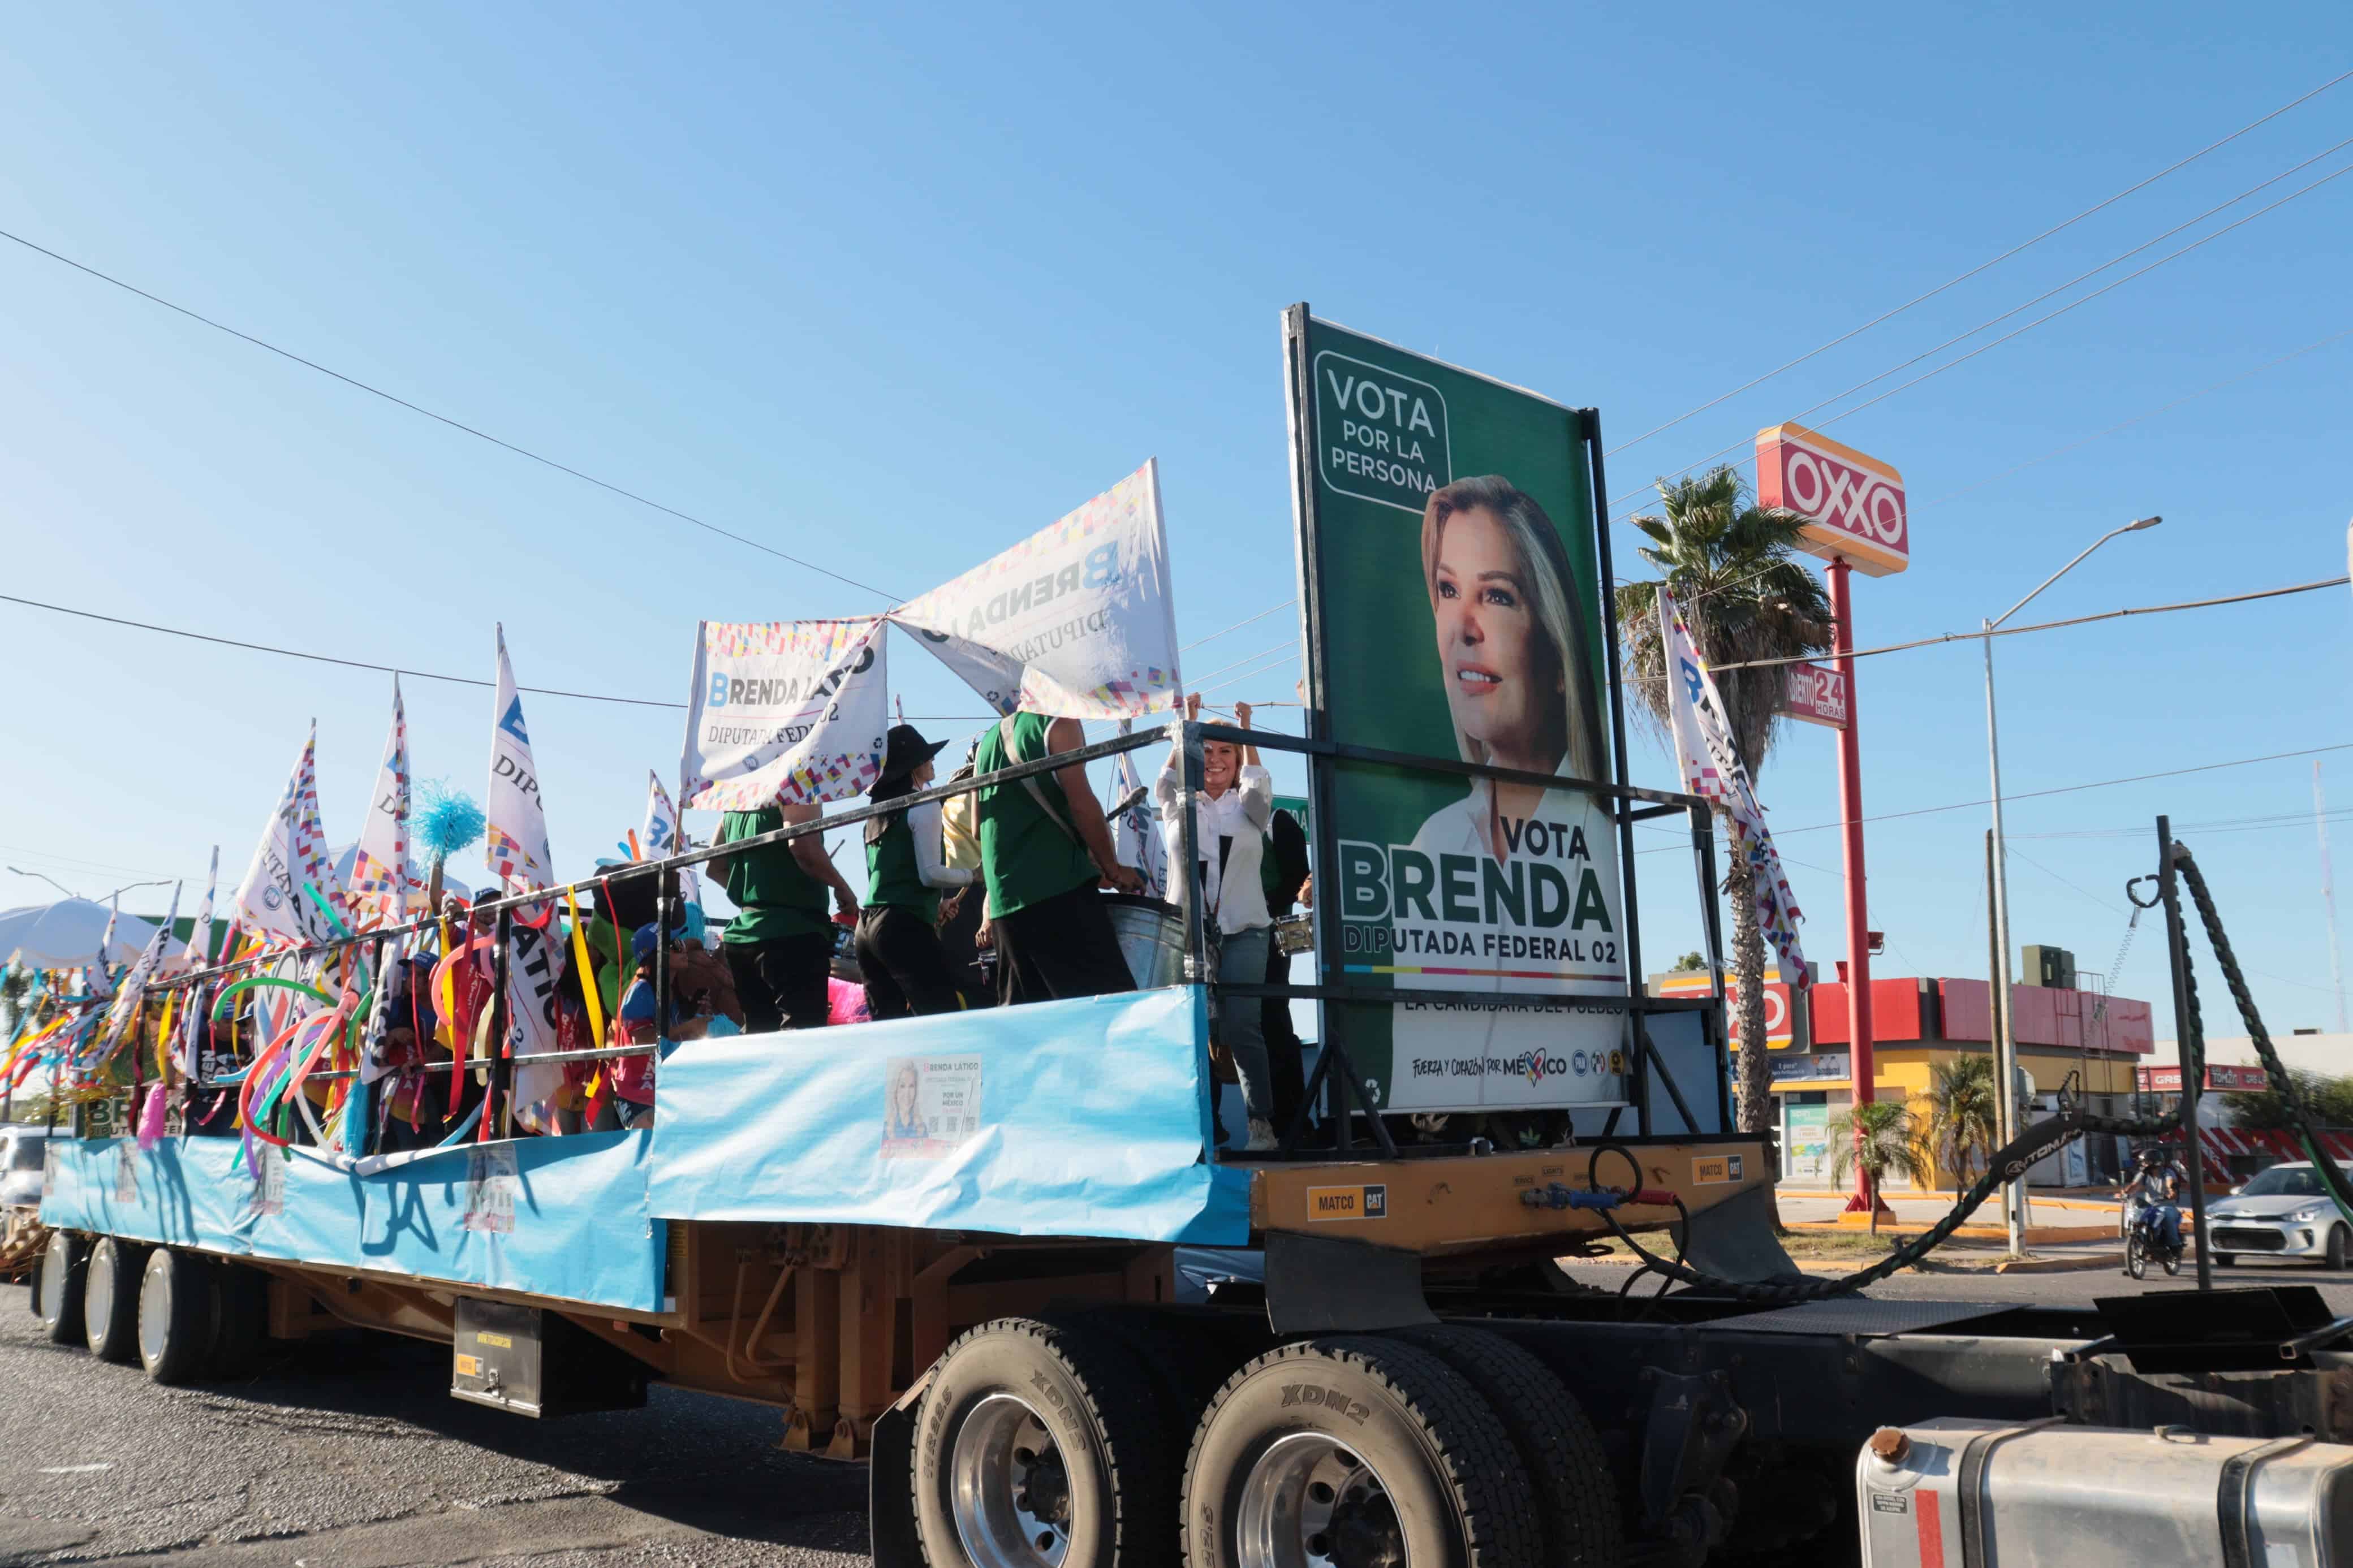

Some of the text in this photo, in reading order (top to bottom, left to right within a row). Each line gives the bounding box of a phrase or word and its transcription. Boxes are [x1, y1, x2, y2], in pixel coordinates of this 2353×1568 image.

[1327, 369, 1436, 438] VOTA
[1343, 420, 1425, 464] POR LA
[1332, 447, 1437, 495] PERSONA
[1787, 452, 1903, 545] OXXO
[708, 671, 799, 707] BRENDA
[1816, 671, 1843, 706] 24
[1816, 702, 1845, 719] HORAS
[777, 723, 815, 743] FED
[1501, 816, 1591, 862] VOTA
[1338, 839, 1613, 933] BRENDA
[1343, 925, 1617, 964] DIPUTADA FEDERAL 02
[1412, 1058, 1443, 1078] FUERZA
[1444, 1059, 1450, 1073] Y
[1451, 1056, 1485, 1076] CORAZÓN
[1486, 1057, 1502, 1075] POR
[1700, 1162, 1740, 1177] MATCO CAT
[1318, 1193, 1383, 1212] MATCO CAT
[1030, 1369, 1087, 1452] XDN2
[1281, 1384, 1371, 1428] XDN2
